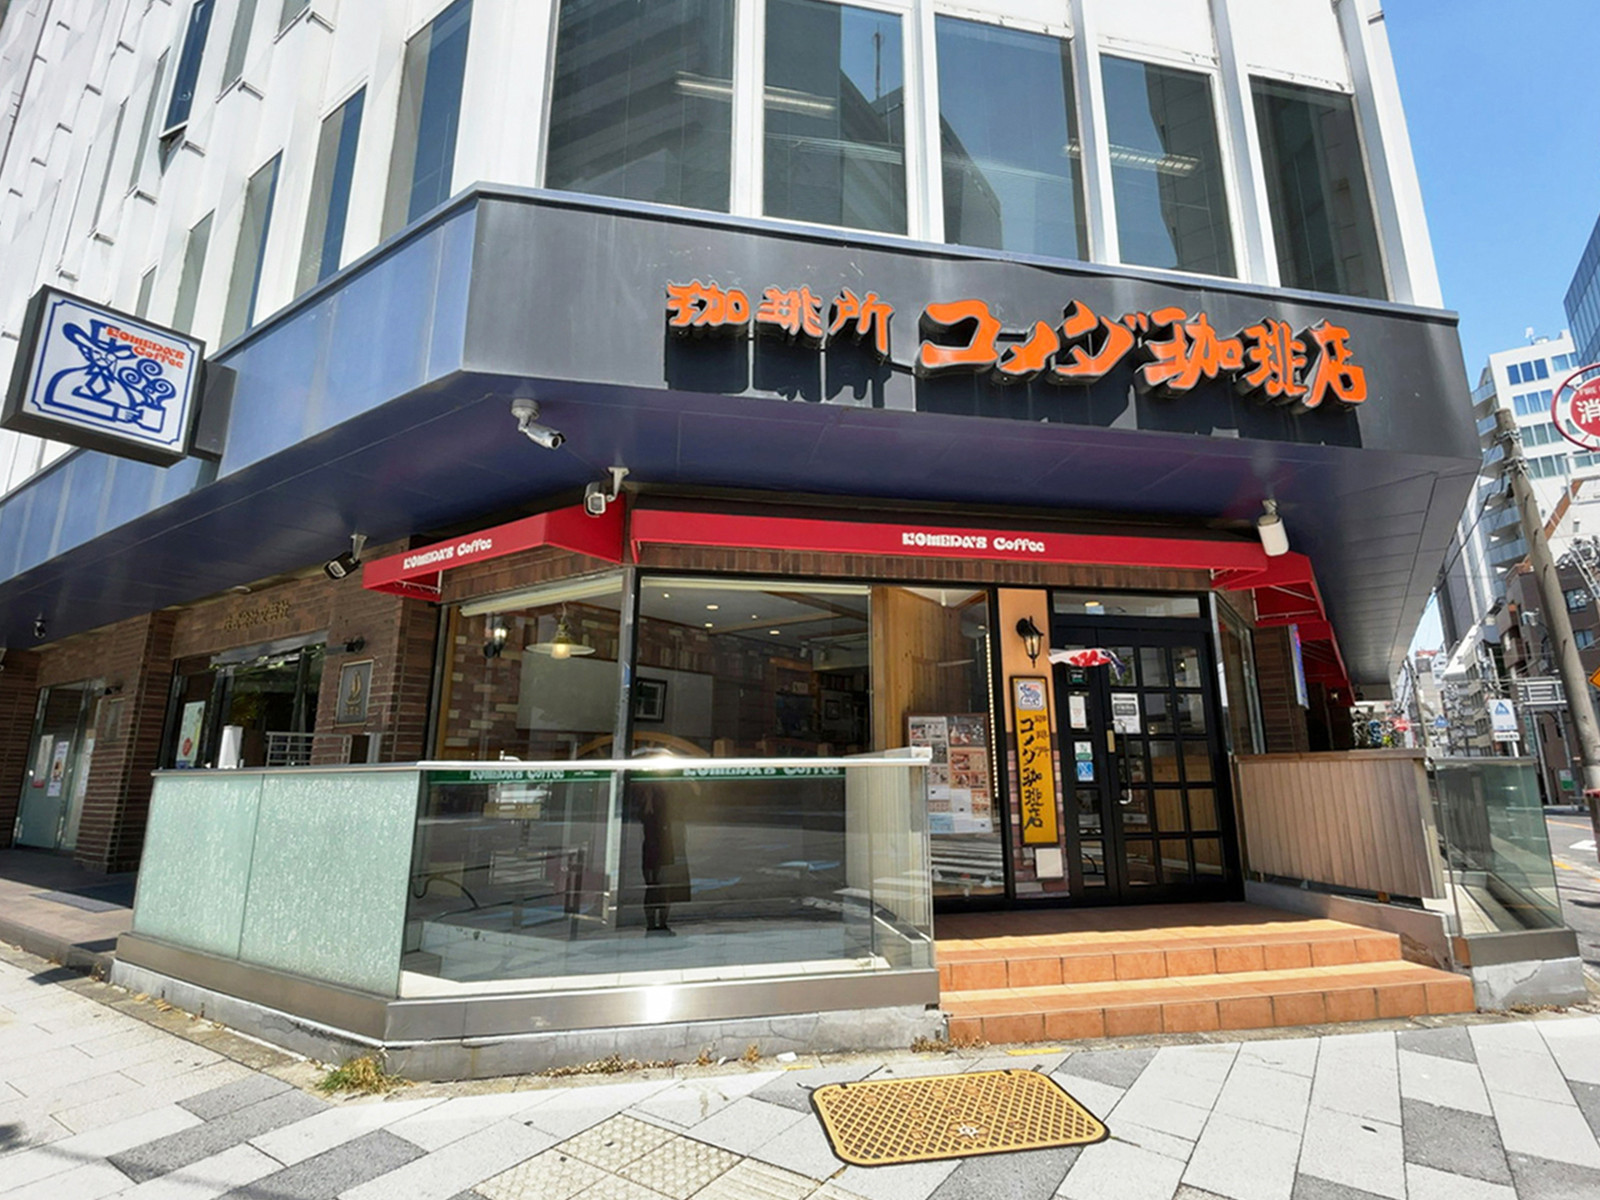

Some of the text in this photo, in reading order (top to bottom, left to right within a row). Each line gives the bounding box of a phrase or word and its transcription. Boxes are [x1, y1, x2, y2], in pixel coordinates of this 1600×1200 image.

[666, 281, 1368, 406] 珈琲所 コメダ珈琲店
[133, 346, 183, 369] Coffee
[457, 538, 493, 557] Coffee
[902, 532, 1045, 552] KOMEDA'S Coffee
